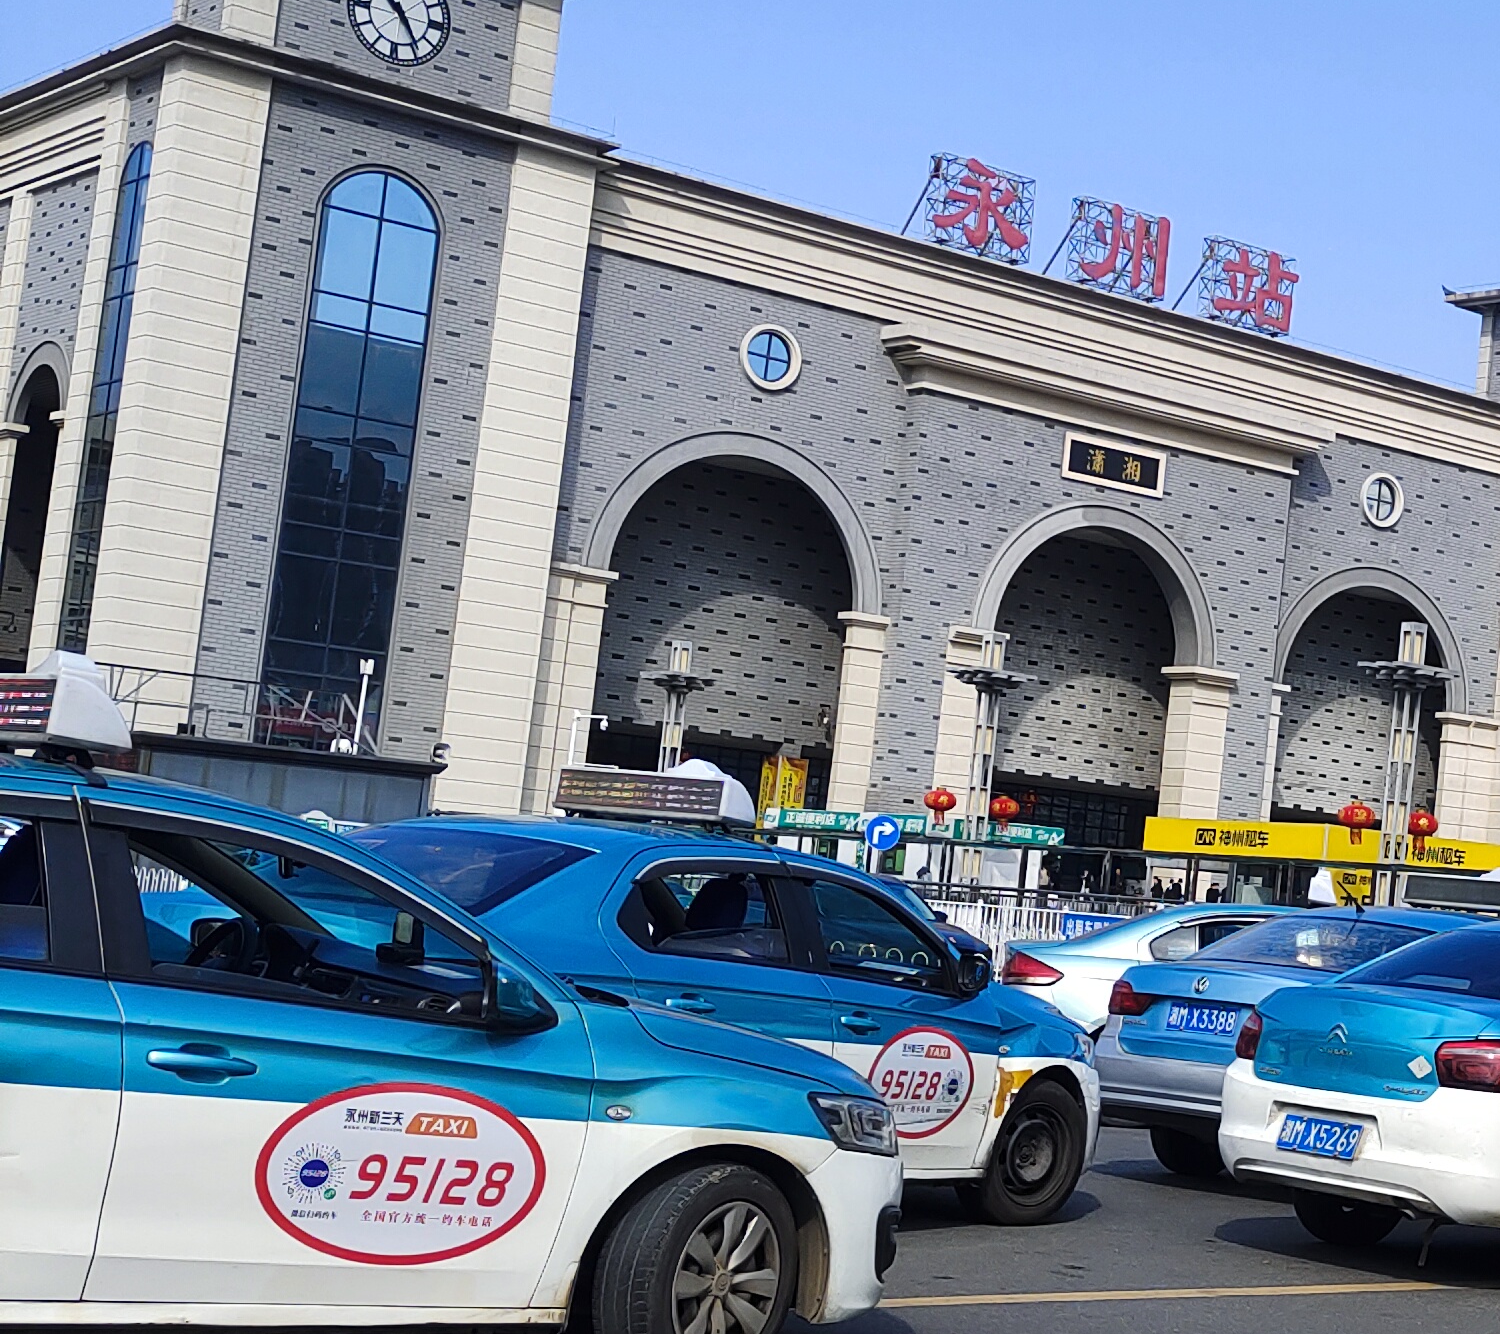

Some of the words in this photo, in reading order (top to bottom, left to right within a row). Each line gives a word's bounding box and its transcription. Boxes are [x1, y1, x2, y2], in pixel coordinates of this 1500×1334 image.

[932, 157, 1300, 334] 永州站
[1218, 828, 1269, 849] 神州租车
[881, 1069, 942, 1101] 95128
[418, 1116, 470, 1135] TAXI
[348, 1154, 515, 1208] 95128
[360, 1209, 493, 1228] 全国官方统一约车电话
